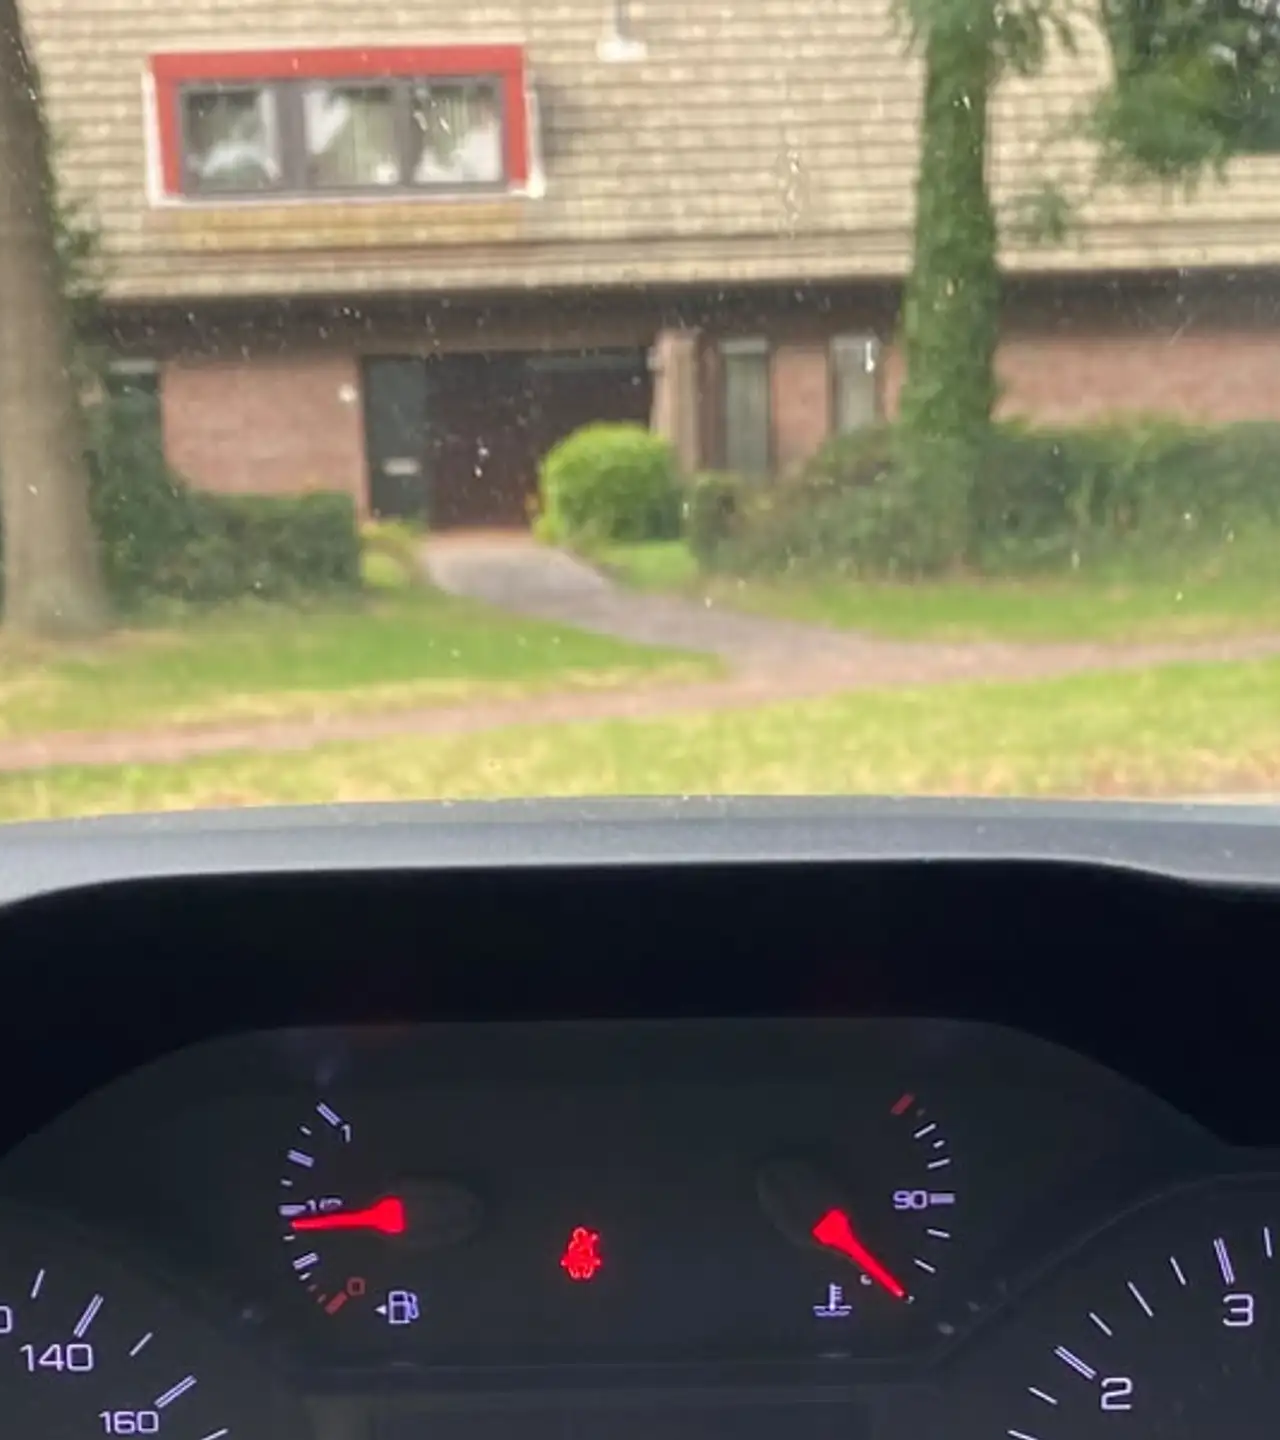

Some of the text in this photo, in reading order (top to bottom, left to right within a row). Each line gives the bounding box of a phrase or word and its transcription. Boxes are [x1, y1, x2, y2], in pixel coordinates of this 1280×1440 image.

[341, 1123, 351, 1143] 1
[893, 1190, 928, 1210] 90
[346, 1277, 366, 1296] 0
[1222, 1293, 1255, 1327] 3
[20, 1343, 94, 1372] 140
[1099, 1377, 1133, 1410] 2
[99, 1410, 159, 1434] 160
